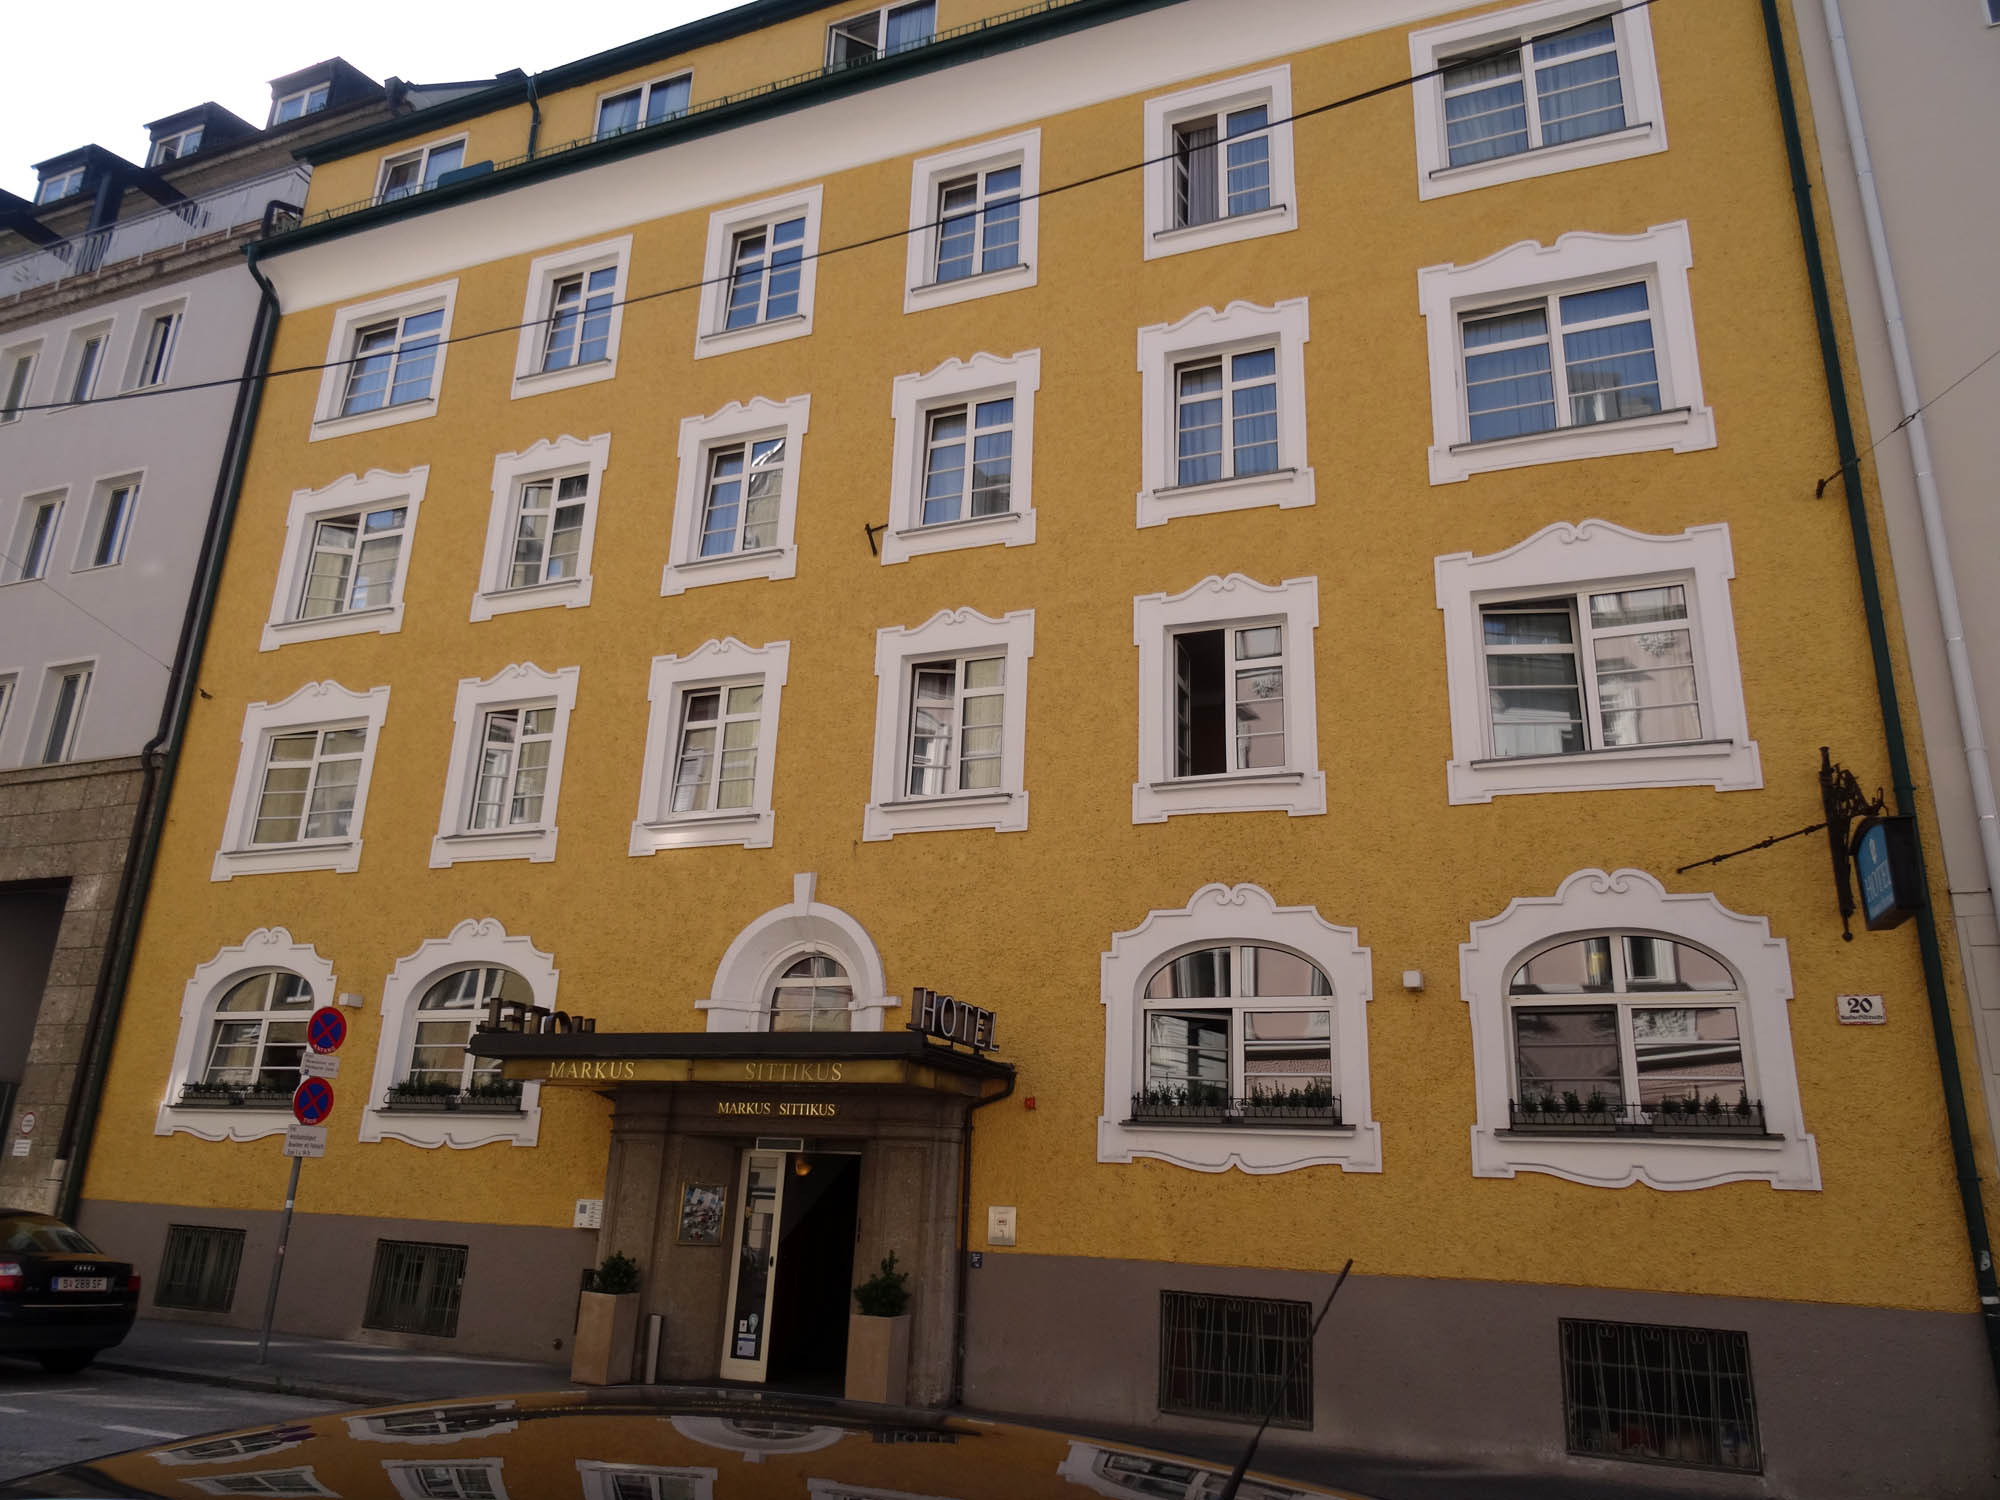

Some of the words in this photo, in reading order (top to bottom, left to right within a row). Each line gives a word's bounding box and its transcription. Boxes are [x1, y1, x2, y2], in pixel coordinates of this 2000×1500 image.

[1847, 997, 1873, 1014] 20
[912, 988, 1000, 1052] HOTEL
[549, 1061, 635, 1080] MARKUS
[745, 1062, 843, 1082] SITTIKUS
[718, 1101, 771, 1115] MARKUS
[778, 1102, 836, 1117] SITTIKUS
